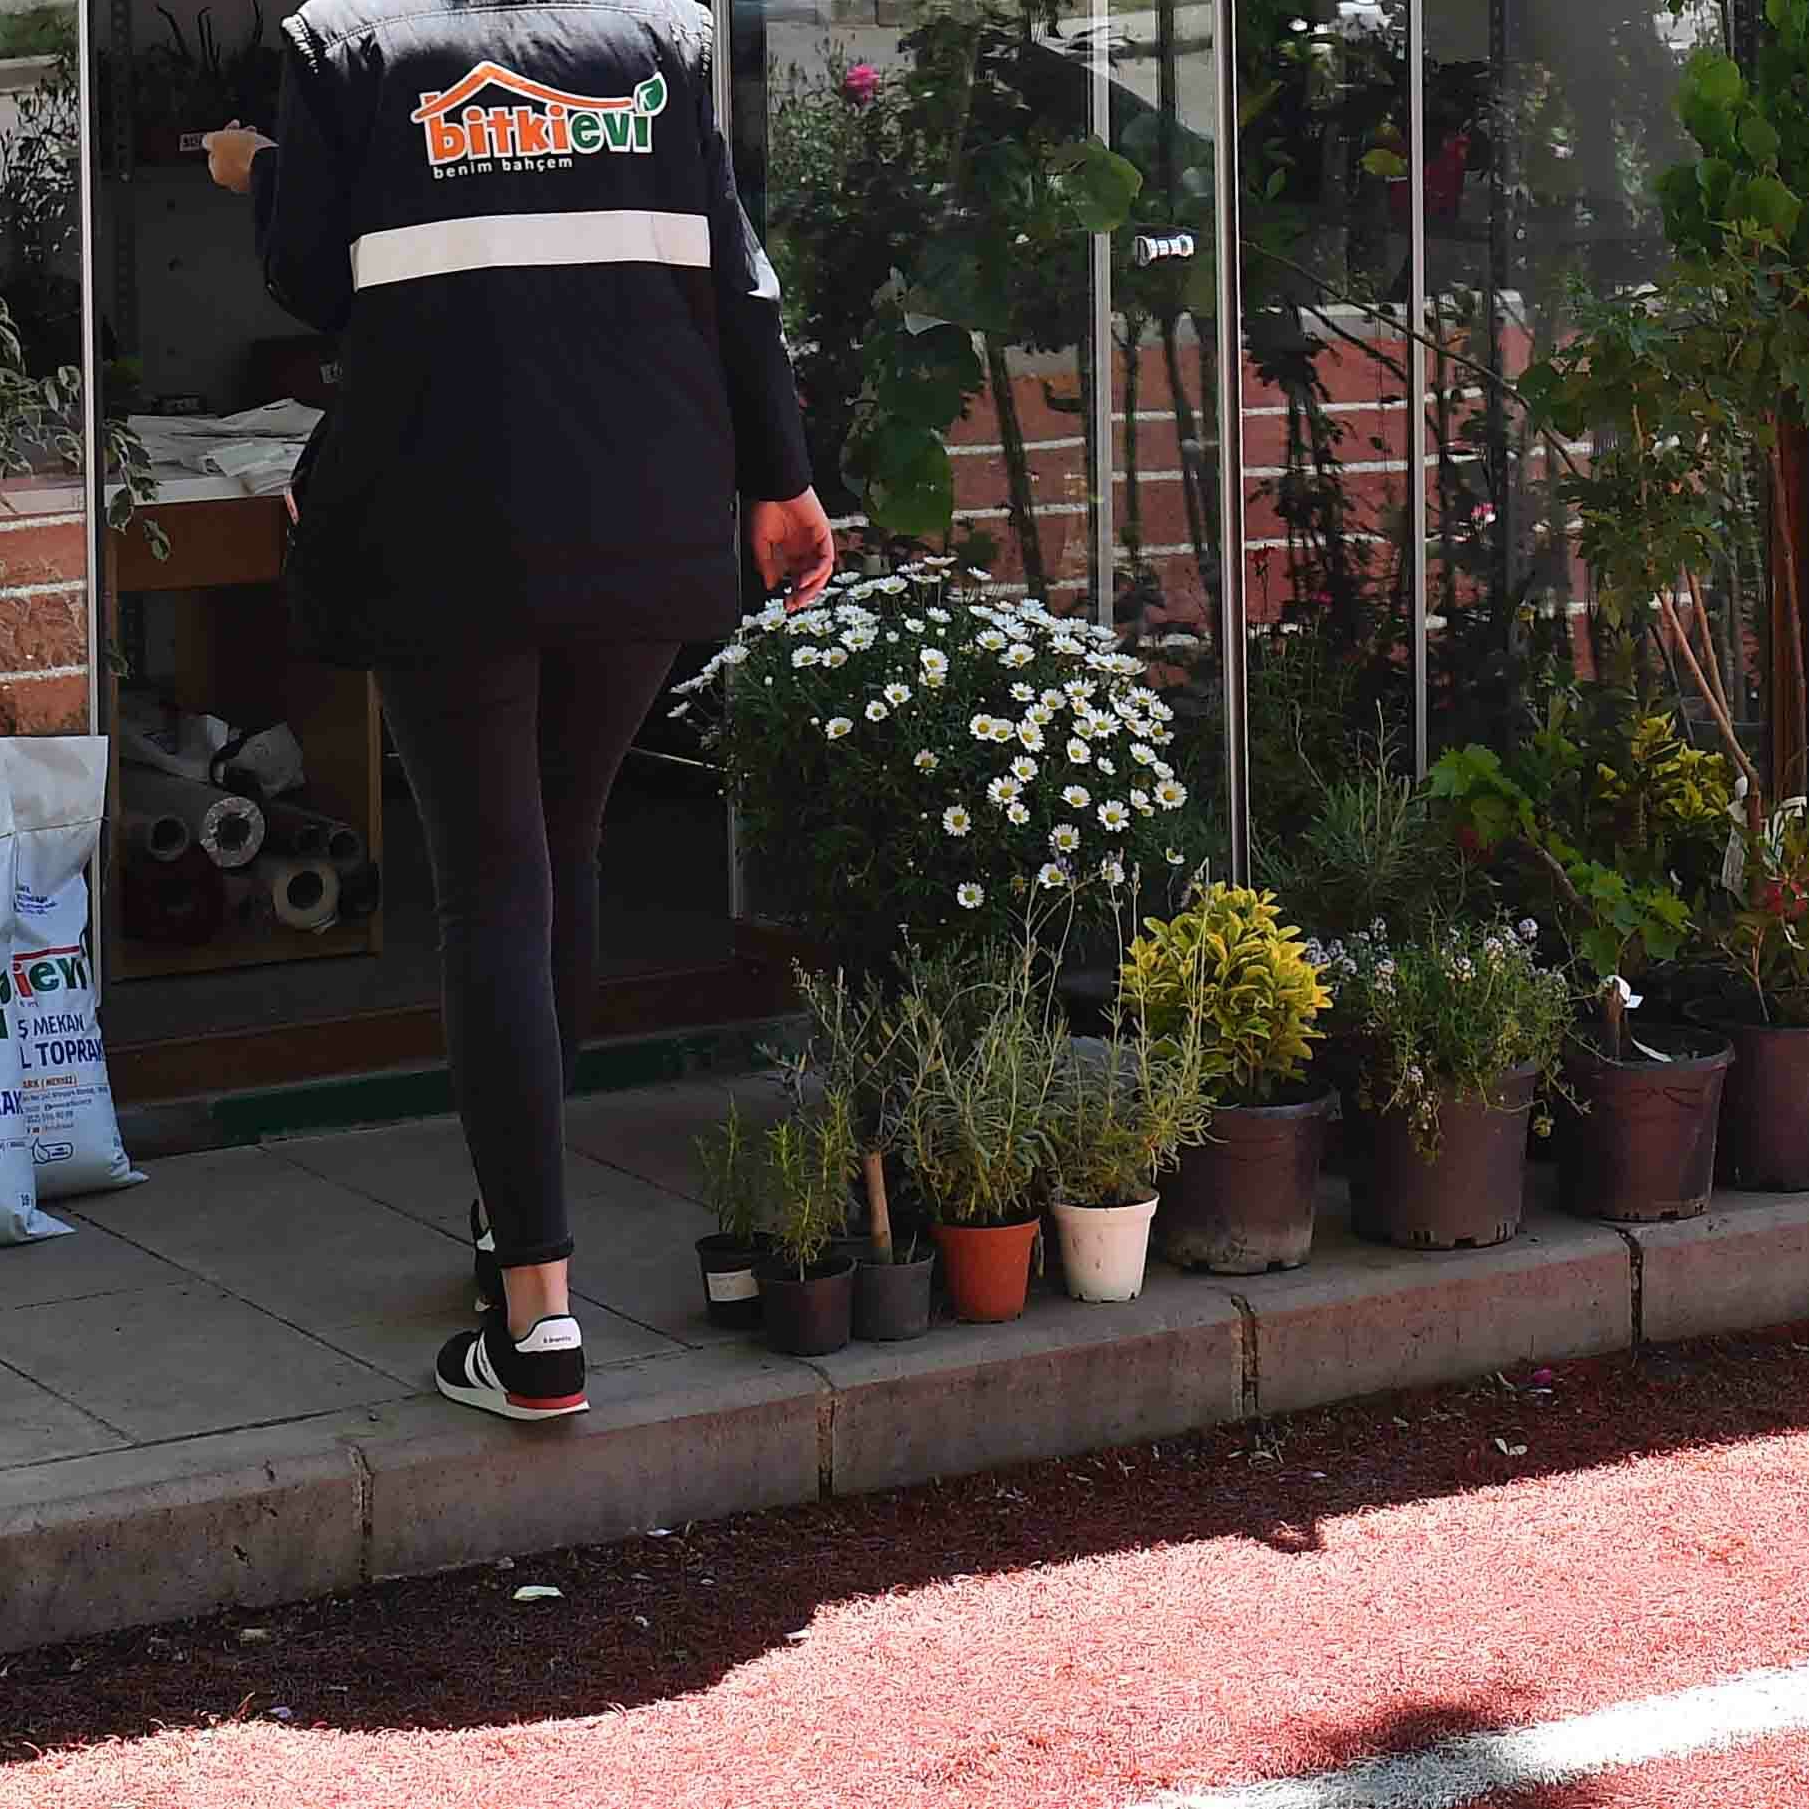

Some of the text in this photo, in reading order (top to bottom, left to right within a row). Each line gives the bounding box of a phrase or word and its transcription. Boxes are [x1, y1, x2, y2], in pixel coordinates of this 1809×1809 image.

[423, 104, 653, 166] bitkievi
[433, 157, 573, 179] benim bahçem
[34, 1013, 85, 1038] MEKAN
